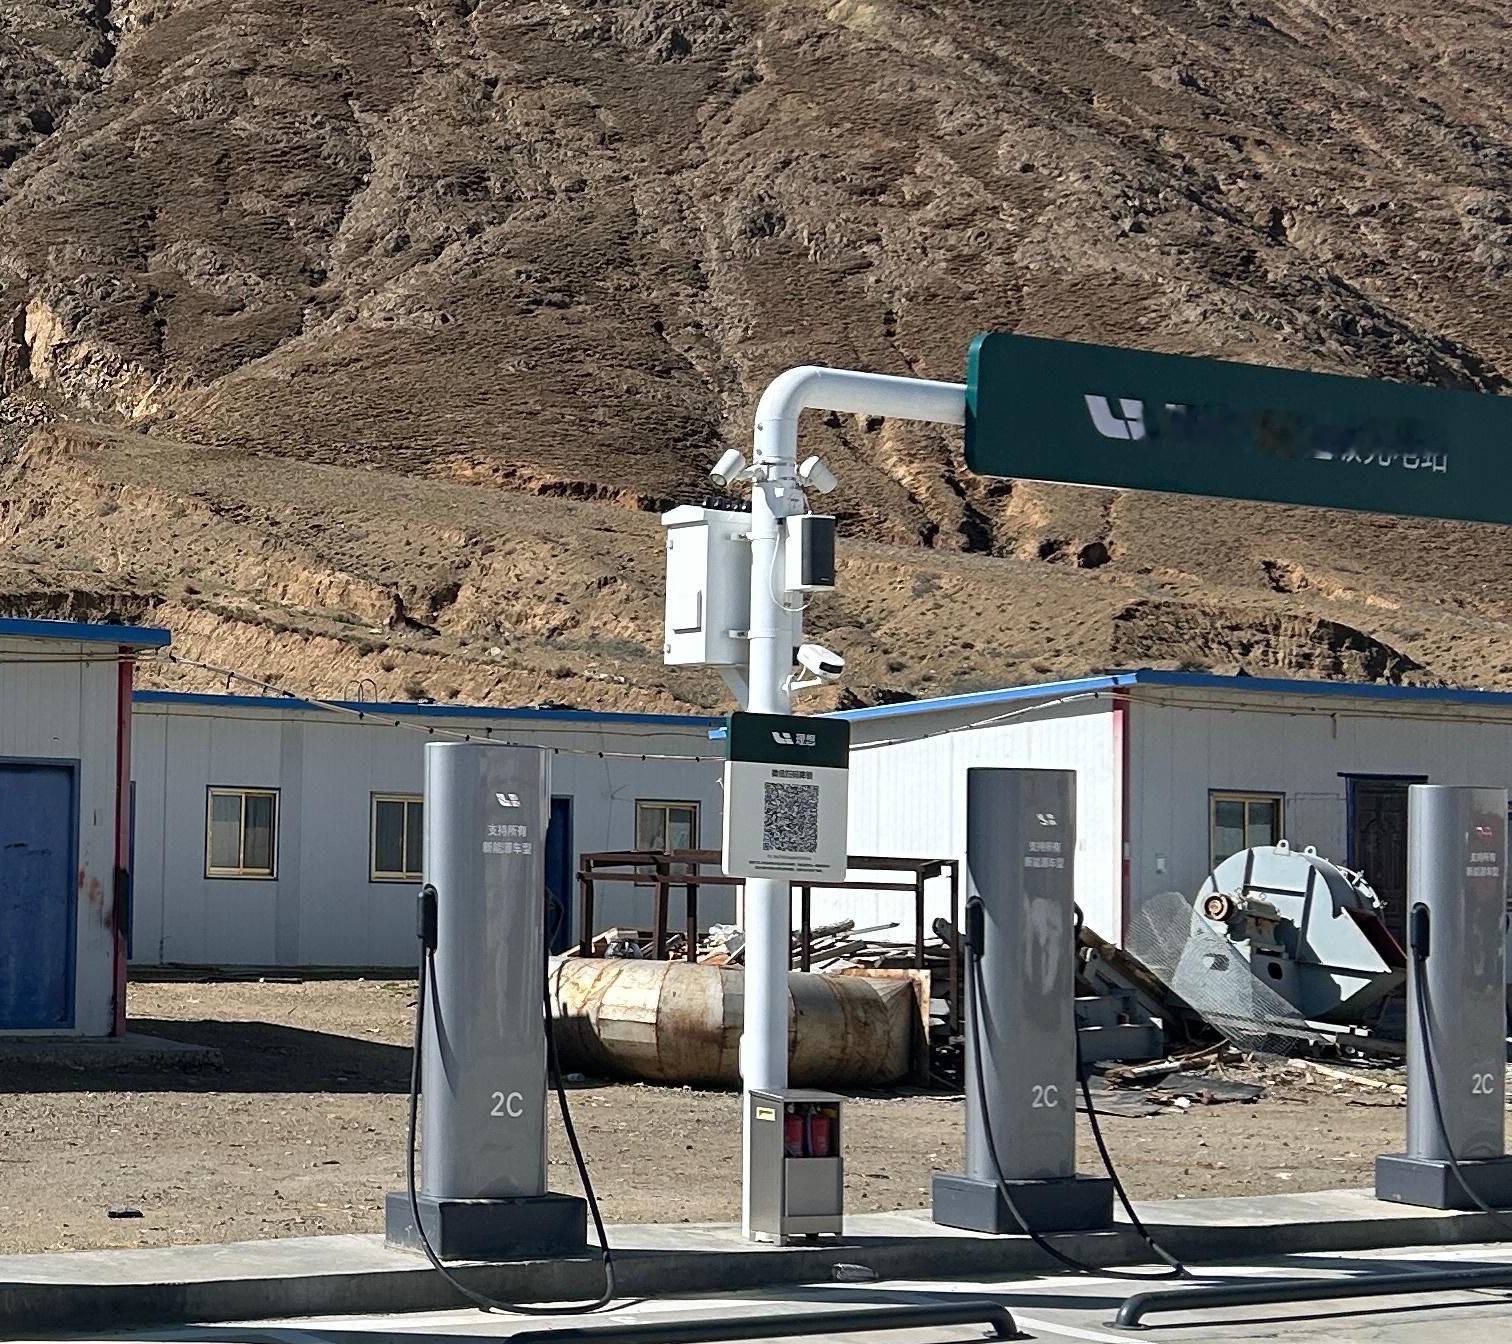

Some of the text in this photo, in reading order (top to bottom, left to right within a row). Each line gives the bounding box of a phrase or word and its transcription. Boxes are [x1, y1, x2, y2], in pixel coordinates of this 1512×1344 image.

[487, 823, 528, 838] 支持所有
[1471, 1072, 1495, 1095] 2C
[490, 1091, 524, 1118] 2C
[1031, 1083, 1059, 1109] 2C
